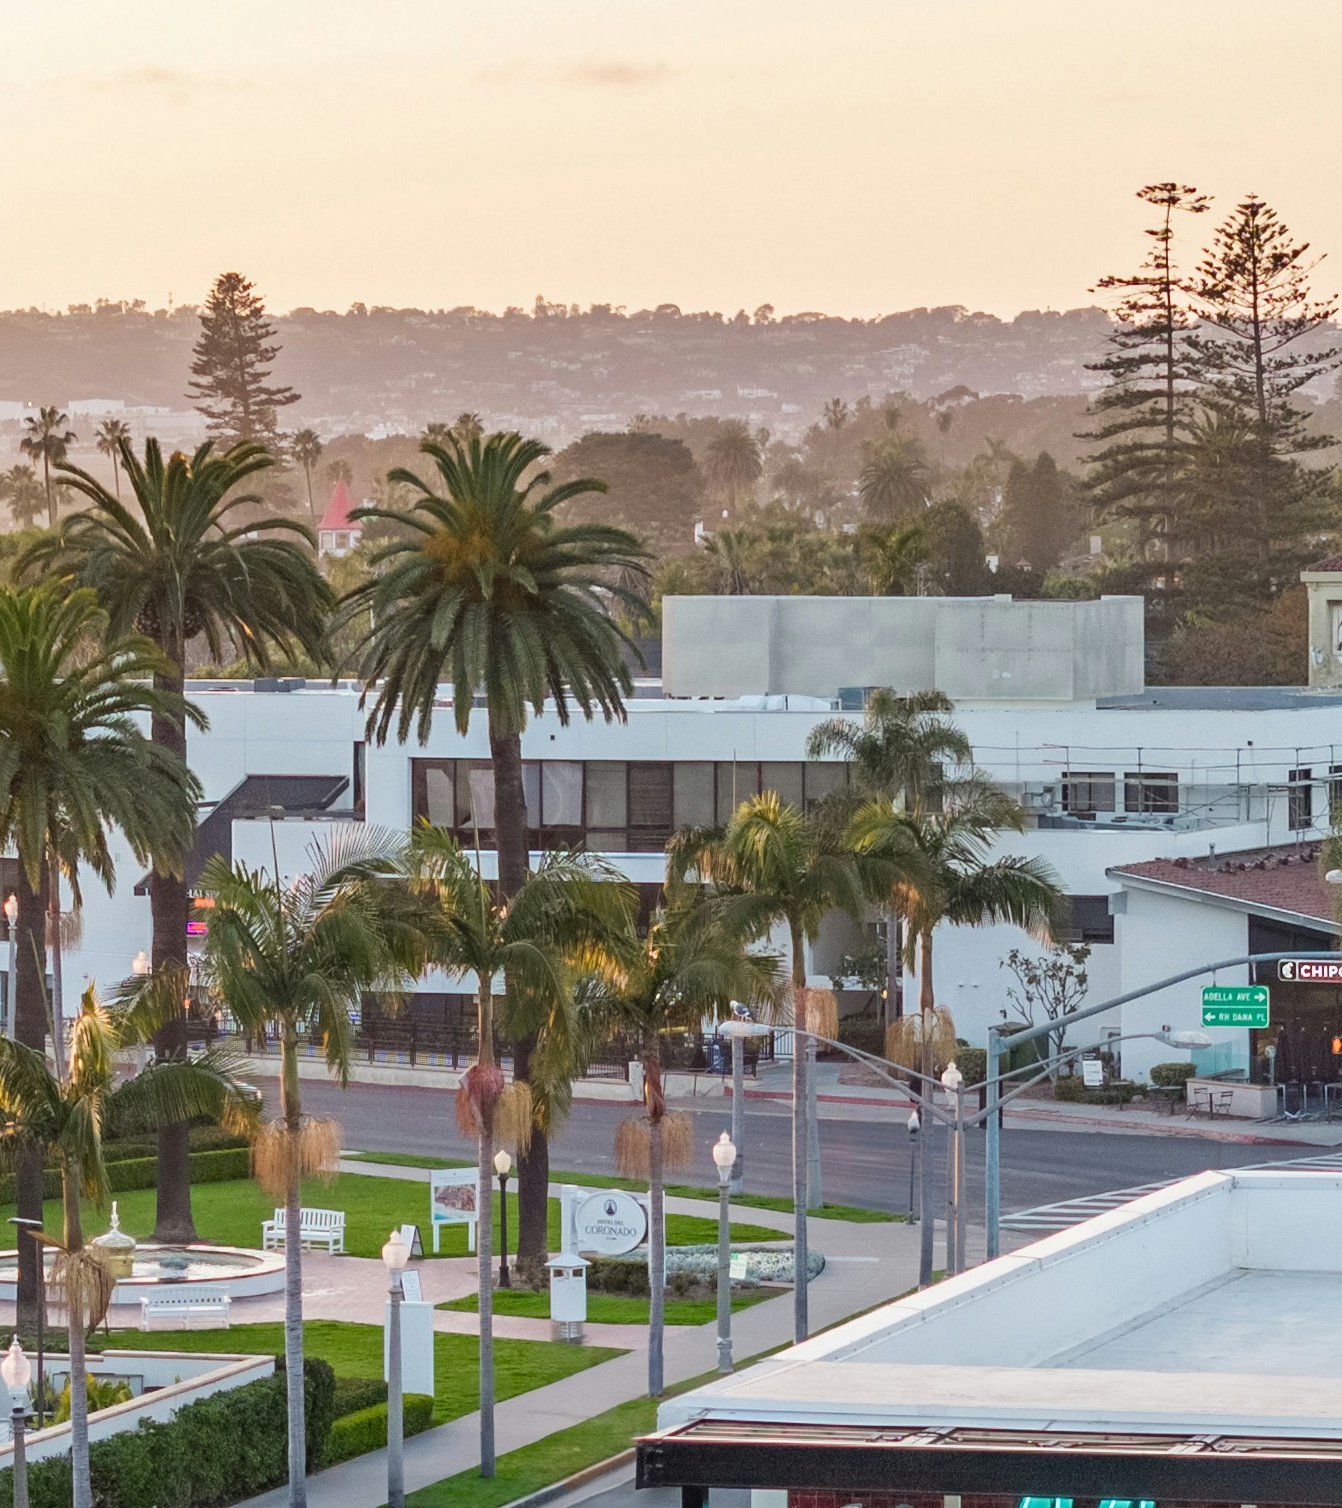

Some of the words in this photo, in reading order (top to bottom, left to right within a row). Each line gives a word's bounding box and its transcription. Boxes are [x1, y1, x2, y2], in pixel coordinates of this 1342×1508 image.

[1203, 992, 1233, 1001] ADELLA
[1236, 992, 1251, 1001] AVE
[1218, 1013, 1230, 1021] RH
[1232, 1013, 1253, 1021] DANA
[1256, 1013, 1266, 1021] PL
[585, 1225, 637, 1237] CORONADO
